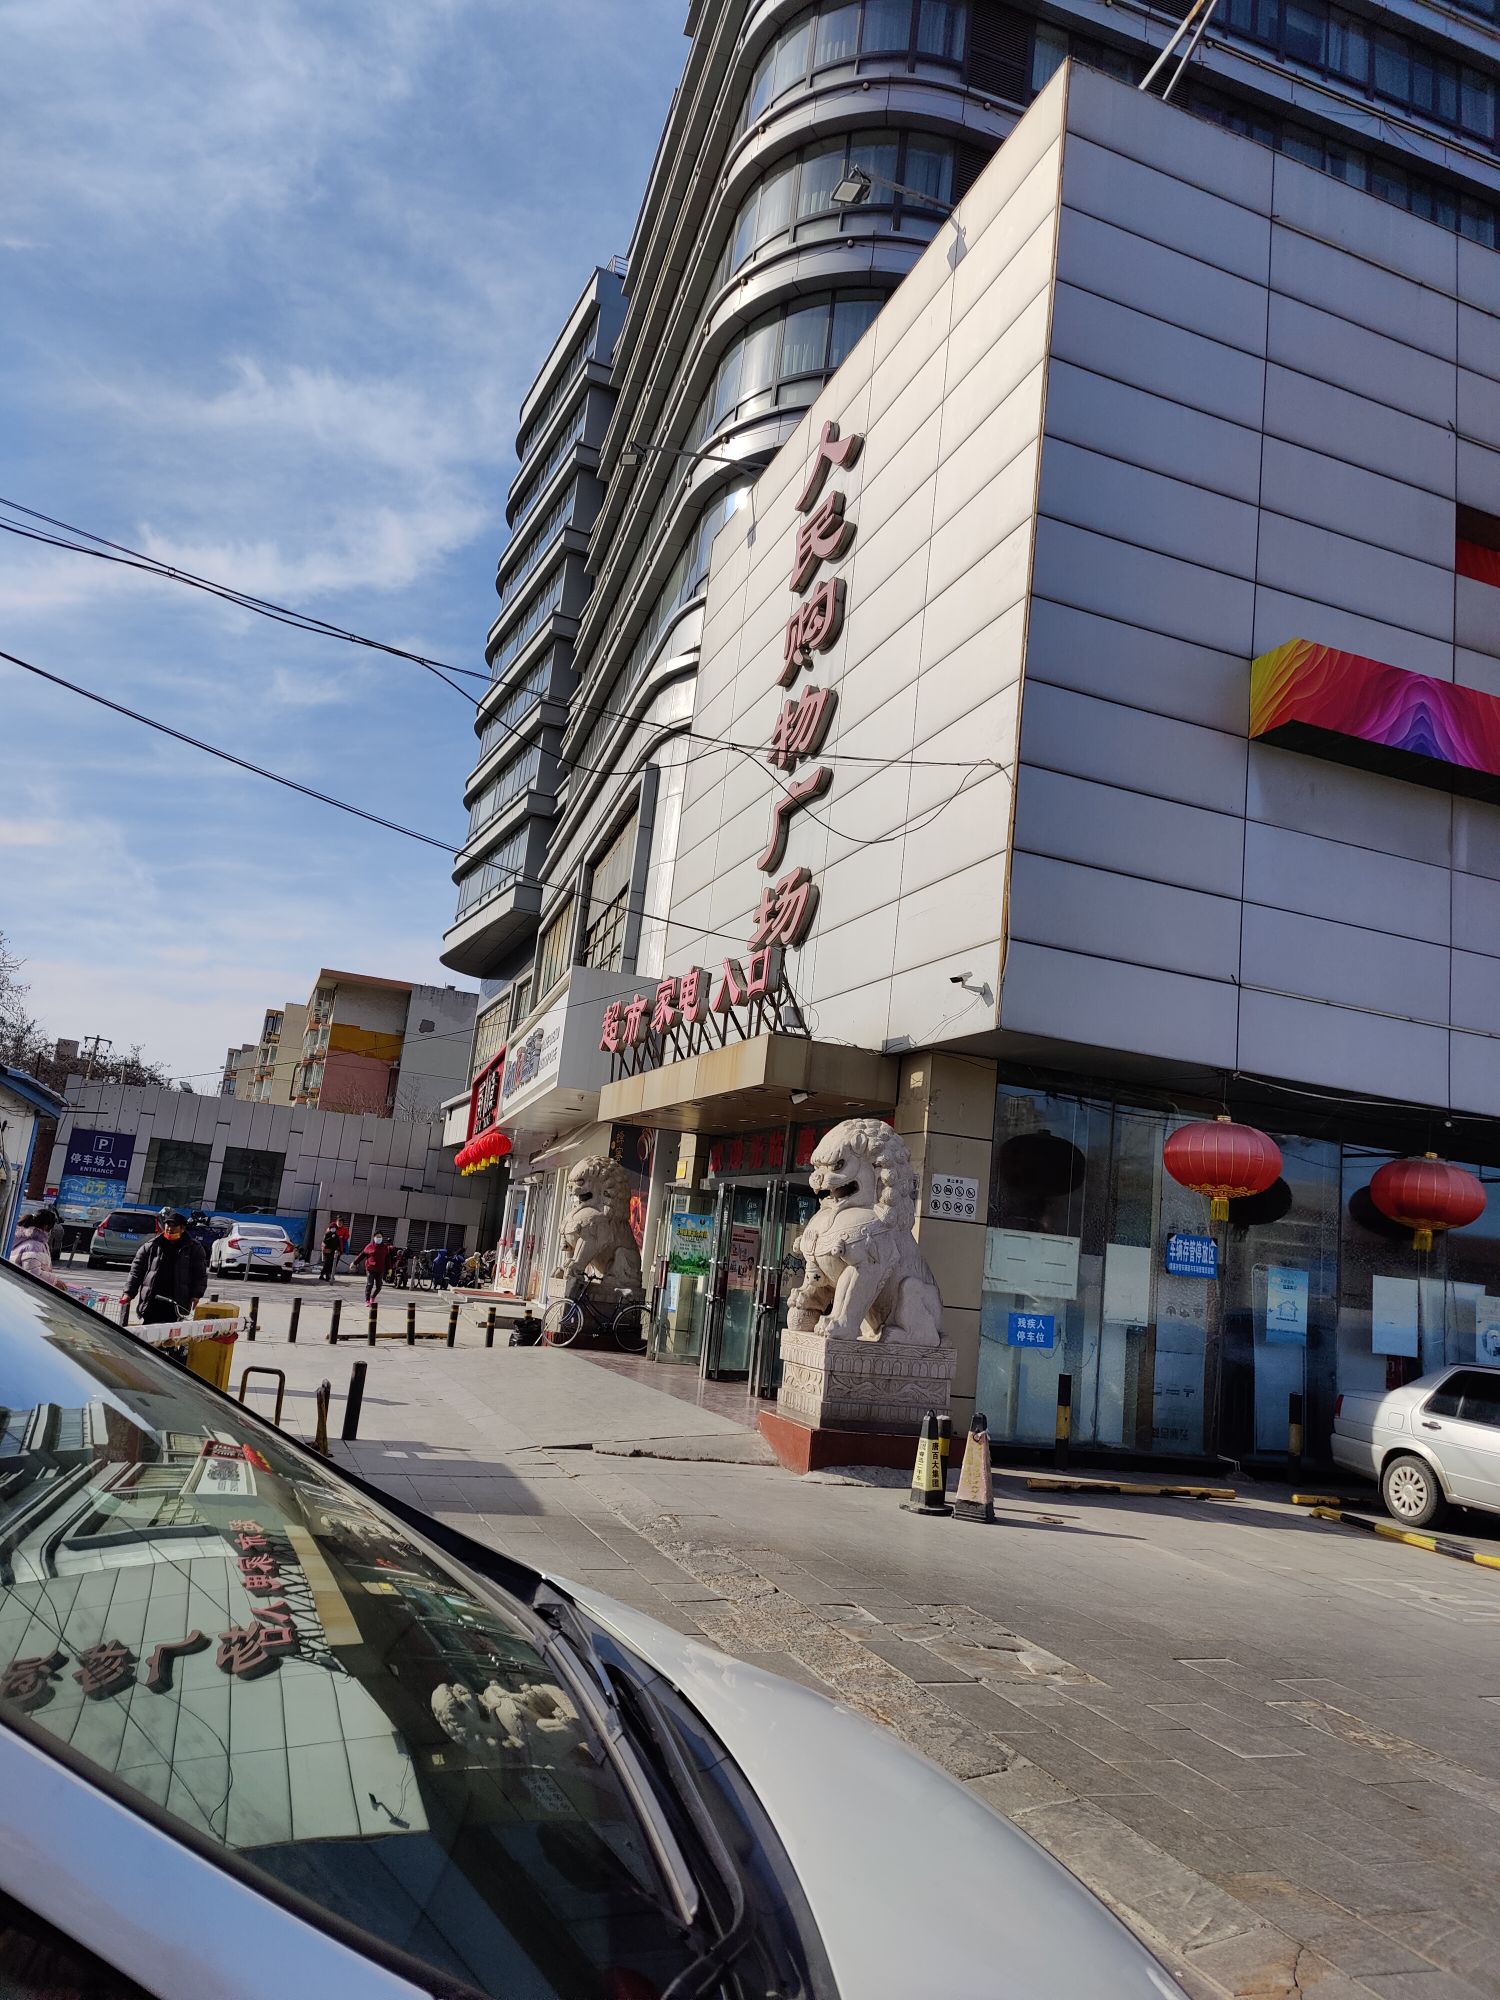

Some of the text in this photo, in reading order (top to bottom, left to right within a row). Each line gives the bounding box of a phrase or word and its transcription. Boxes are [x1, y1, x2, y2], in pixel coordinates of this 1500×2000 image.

[748, 419, 864, 951] 人民购物广场
[98, 1139, 109, 1150] P
[70, 1152, 128, 1168] 停车场入口
[80, 1166, 115, 1175] ENTRANCE
[1169, 1237, 1215, 1265] 车辆存管停放区
[1017, 1317, 1046, 1330] 残疾人
[1016, 1331, 1045, 1343] 停车位
[931, 1442, 940, 1488] 唐百大集团
